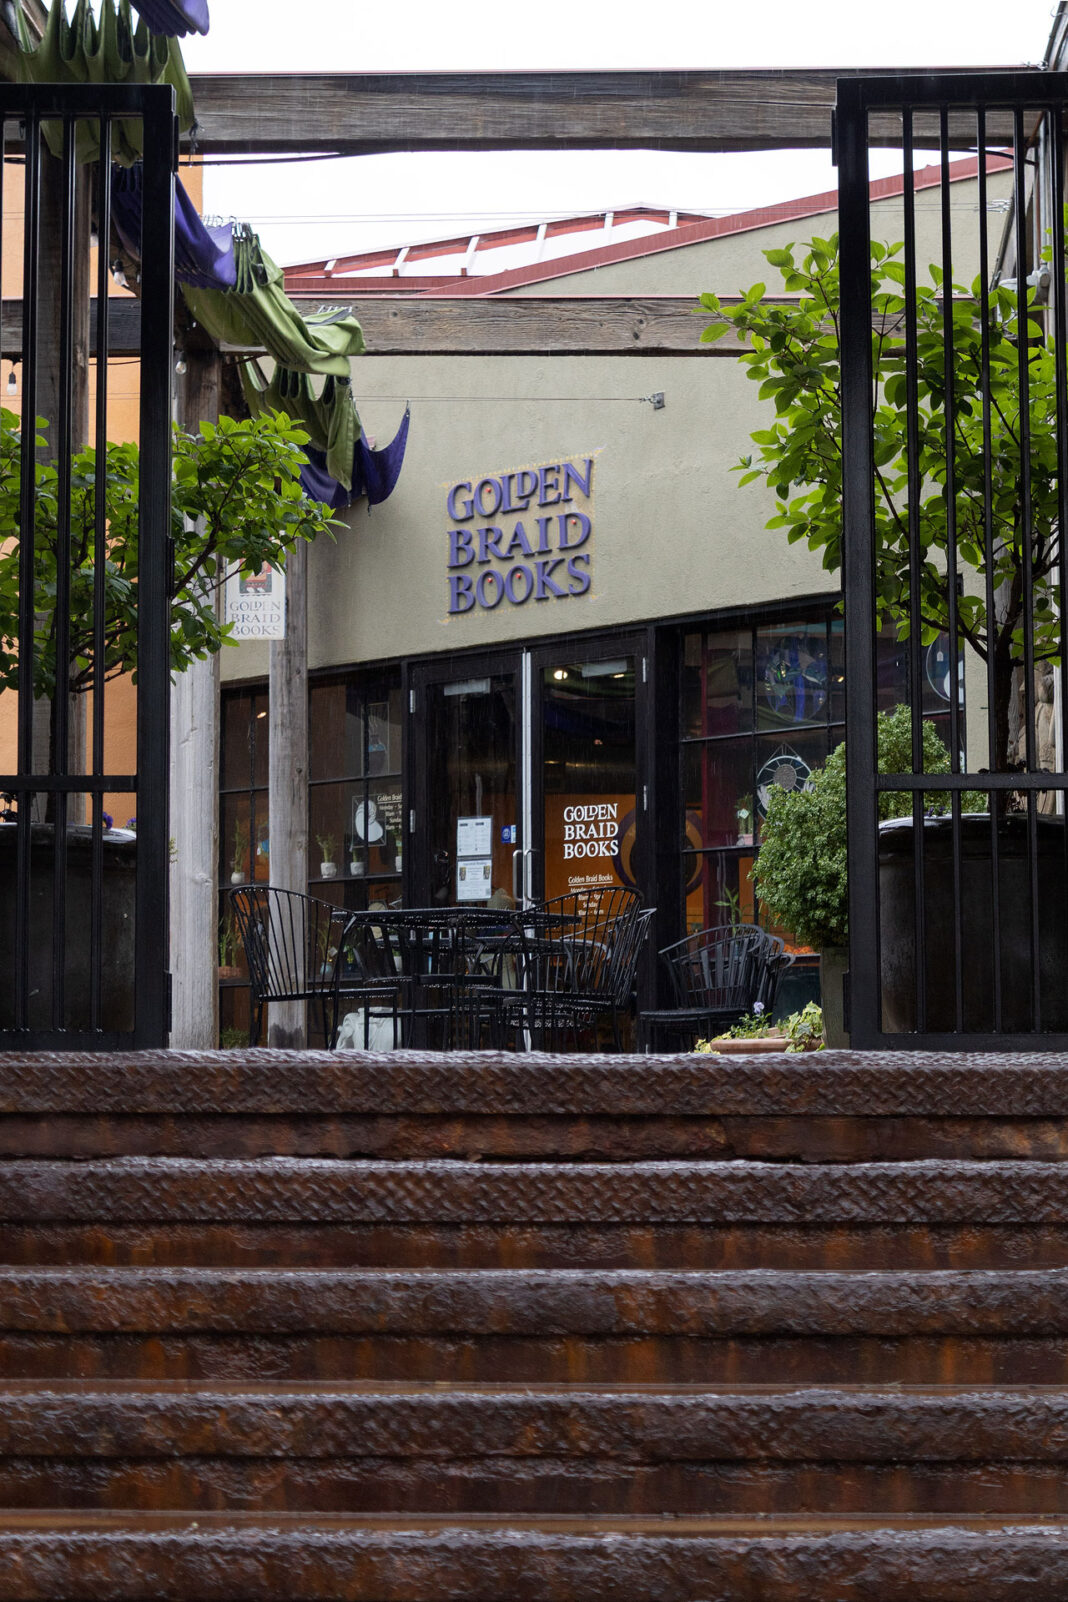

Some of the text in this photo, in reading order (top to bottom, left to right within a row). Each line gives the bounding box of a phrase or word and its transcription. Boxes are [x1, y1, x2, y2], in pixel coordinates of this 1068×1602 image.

[447, 458, 593, 522] GOLDEN
[447, 512, 592, 569] BRAID
[447, 553, 591, 614] BOOKS
[230, 601, 280, 612] GOLDEN
[231, 613, 280, 623] BRAID
[231, 624, 280, 636] BOOKS
[563, 803, 618, 822] GOLDEN
[564, 821, 619, 840] BRAID
[563, 840, 619, 859] BOOKS
[586, 874, 598, 882] Braid
[598, 873, 613, 881] Books
